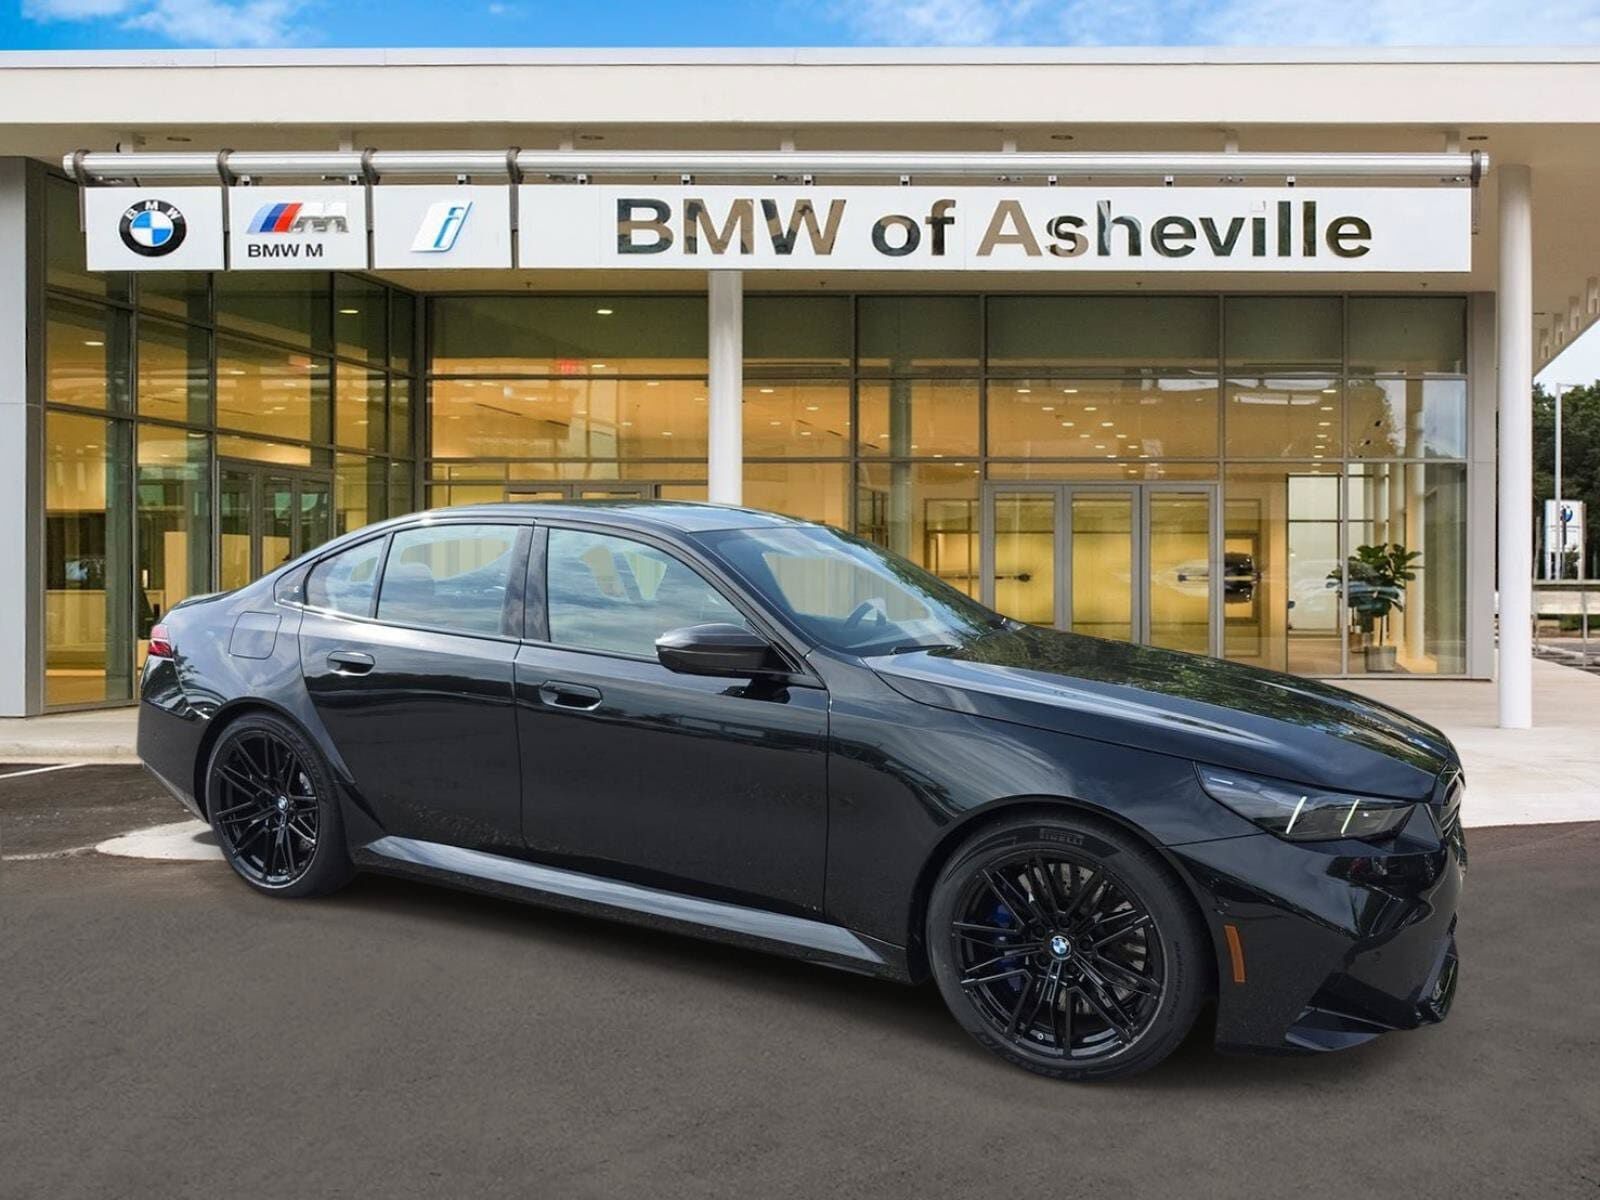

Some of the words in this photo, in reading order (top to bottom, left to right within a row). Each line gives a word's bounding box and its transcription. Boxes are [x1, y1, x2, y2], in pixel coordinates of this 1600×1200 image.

[125, 201, 181, 220] BMW
[617, 198, 847, 256] BMW
[871, 199, 956, 257] of
[976, 199, 1372, 258] Asheville
[247, 243, 300, 258] BMW
[305, 243, 324, 258] M
